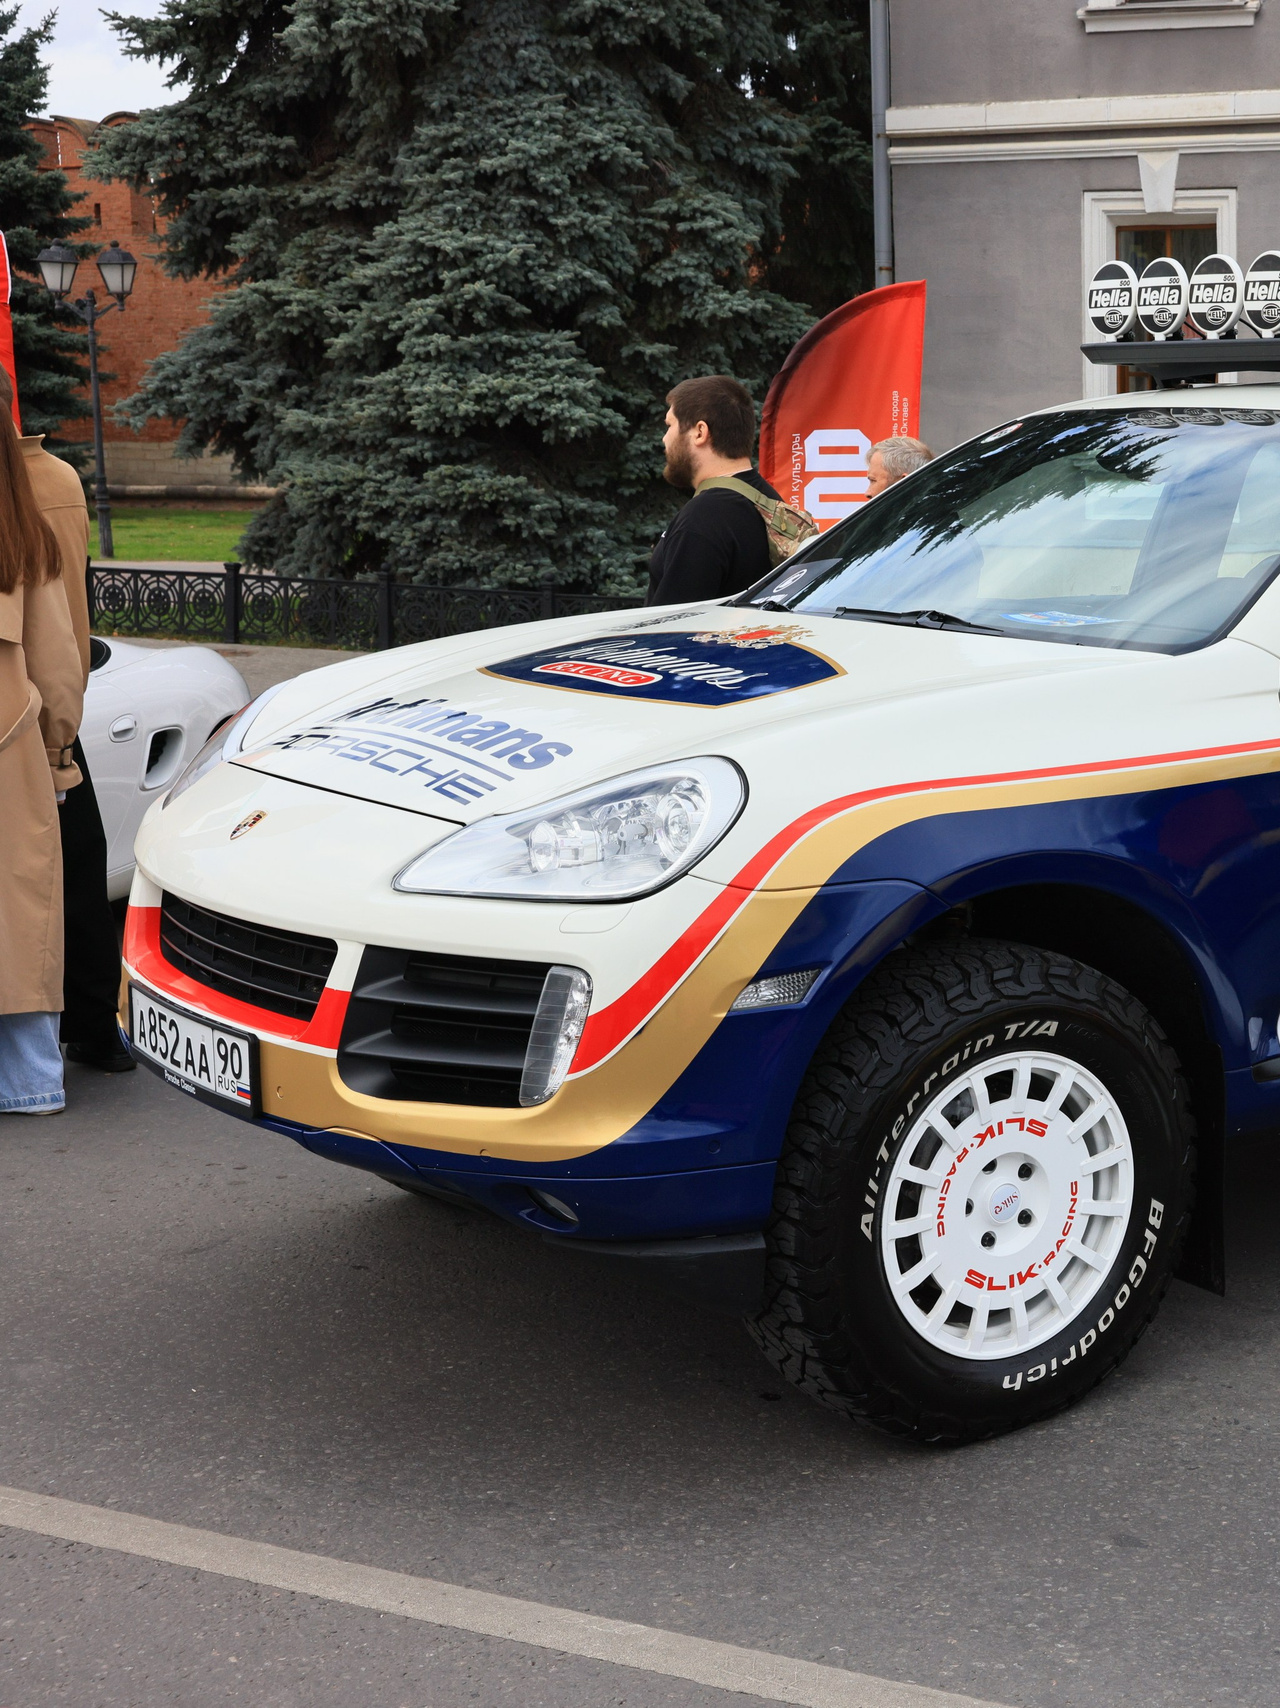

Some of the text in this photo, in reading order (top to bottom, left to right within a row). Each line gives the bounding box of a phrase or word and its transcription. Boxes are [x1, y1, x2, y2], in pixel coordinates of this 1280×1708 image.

[1091, 289, 1130, 308] Hella
[1139, 287, 1180, 306] Hella
[1191, 284, 1235, 303] Hella
[1105, 314, 1123, 322] HELLA
[1155, 312, 1173, 320] HELLA
[1208, 310, 1227, 318] HELLA
[891, 390, 900, 421] города
[791, 433, 804, 491] культуры
[543, 662, 649, 685] RACING
[216, 1037, 242, 1080] 90
[218, 1075, 236, 1094] RUS
[860, 1019, 1059, 1242] All-Terrain T/A
[1002, 1197, 1165, 1391] BFGoodrich
